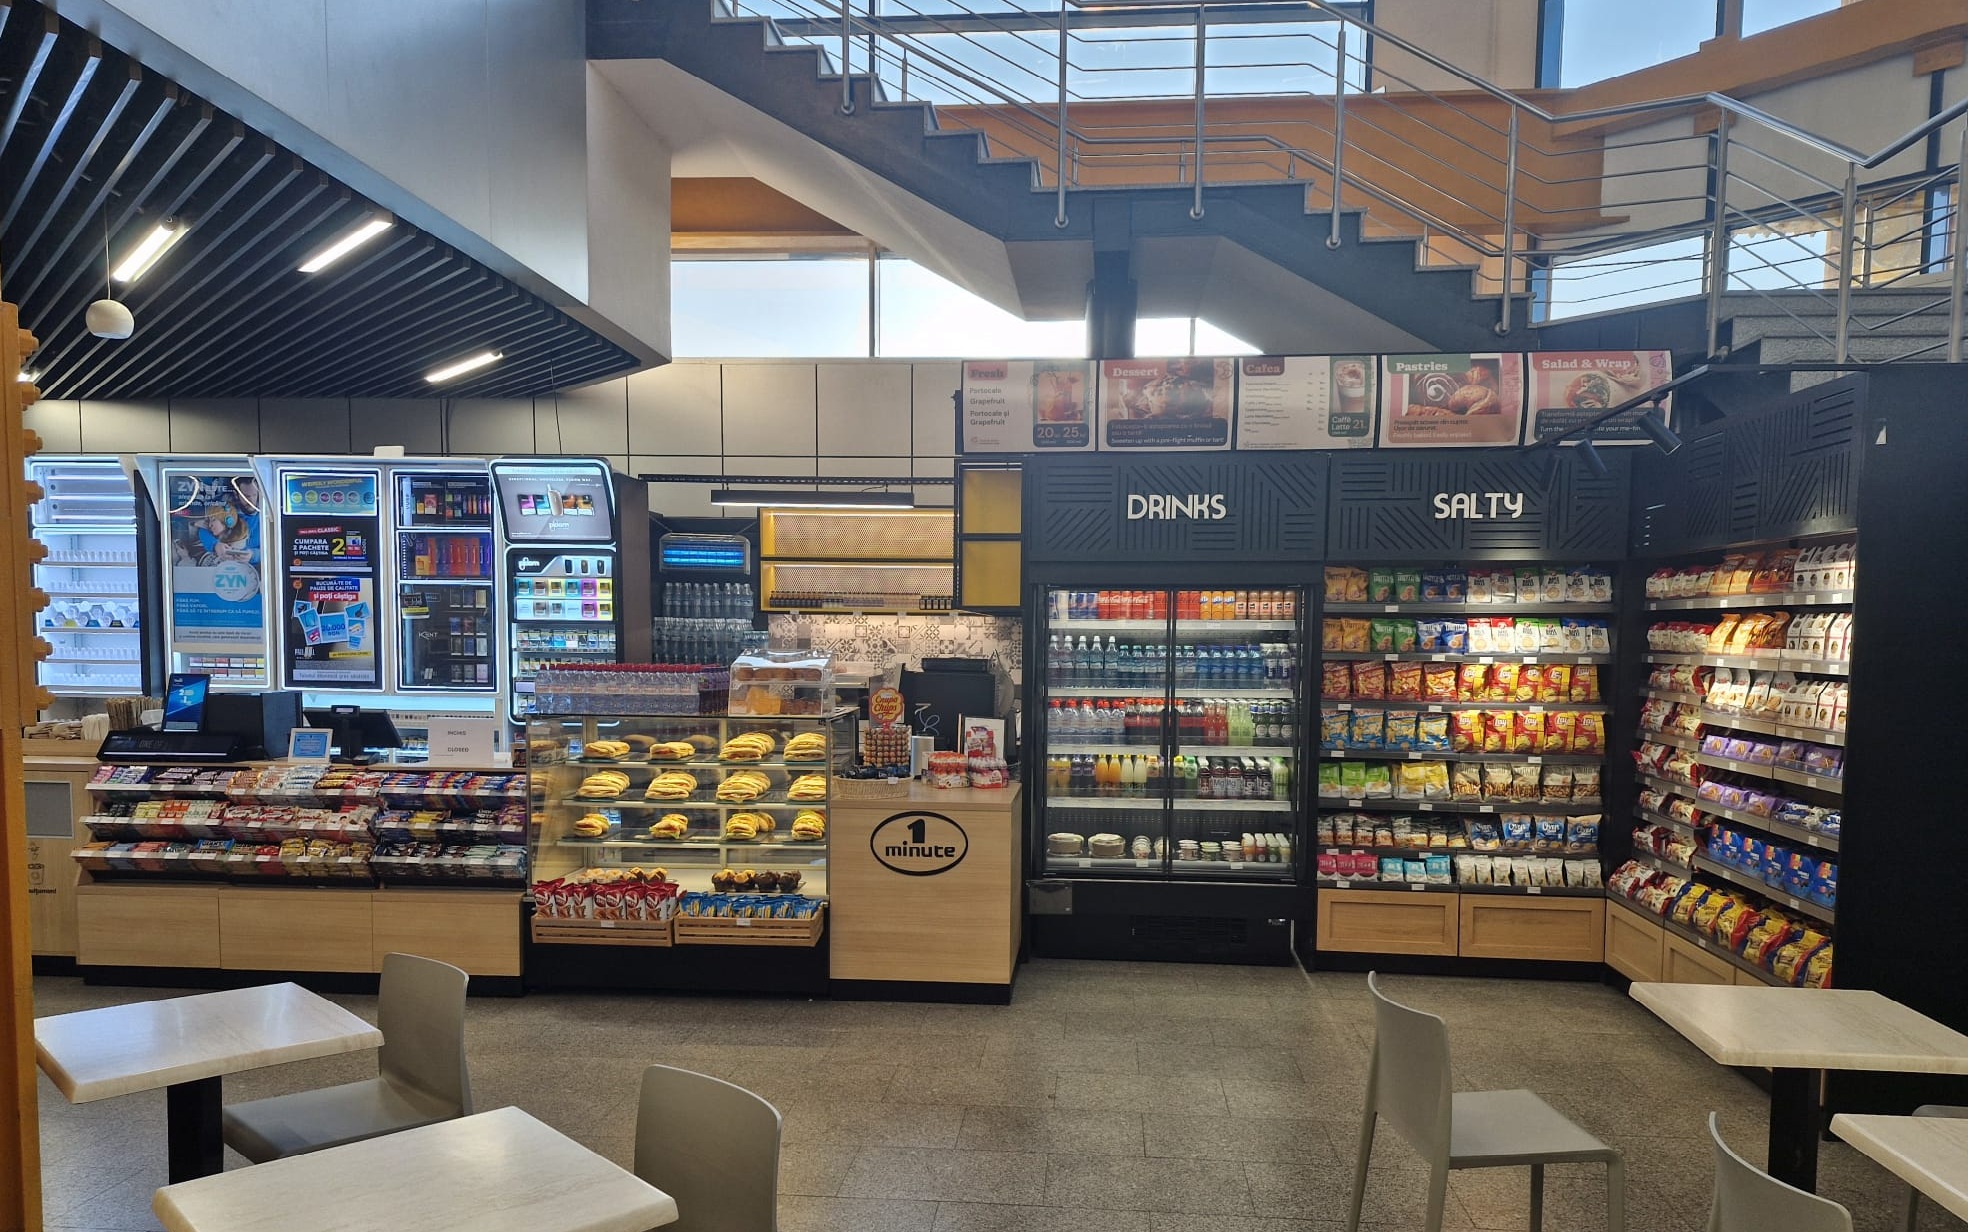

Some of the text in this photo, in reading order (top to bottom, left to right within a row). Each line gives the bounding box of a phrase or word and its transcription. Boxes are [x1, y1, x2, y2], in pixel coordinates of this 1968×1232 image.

[1396, 361, 1449, 372] Pastries
[1542, 359, 1631, 372] Salad & Wrap
[970, 368, 1005, 379] Fresh
[1112, 367, 1160, 377] Dessert
[969, 398, 1006, 406] Grapefruit
[969, 410, 1003, 418] Portocale
[969, 419, 1006, 427] Grapefruit
[1038, 427, 1055, 439] 20
[1063, 426, 1080, 438] 25
[1127, 494, 1227, 520] DRINKS
[1433, 492, 1524, 520] SALTY
[331, 538, 345, 555] 2
[215, 574, 247, 588] ZYN
[418, 632, 439, 640] KENT
[873, 703, 897, 714] Chups
[906, 819, 926, 844] 1
[885, 840, 956, 858] minute
